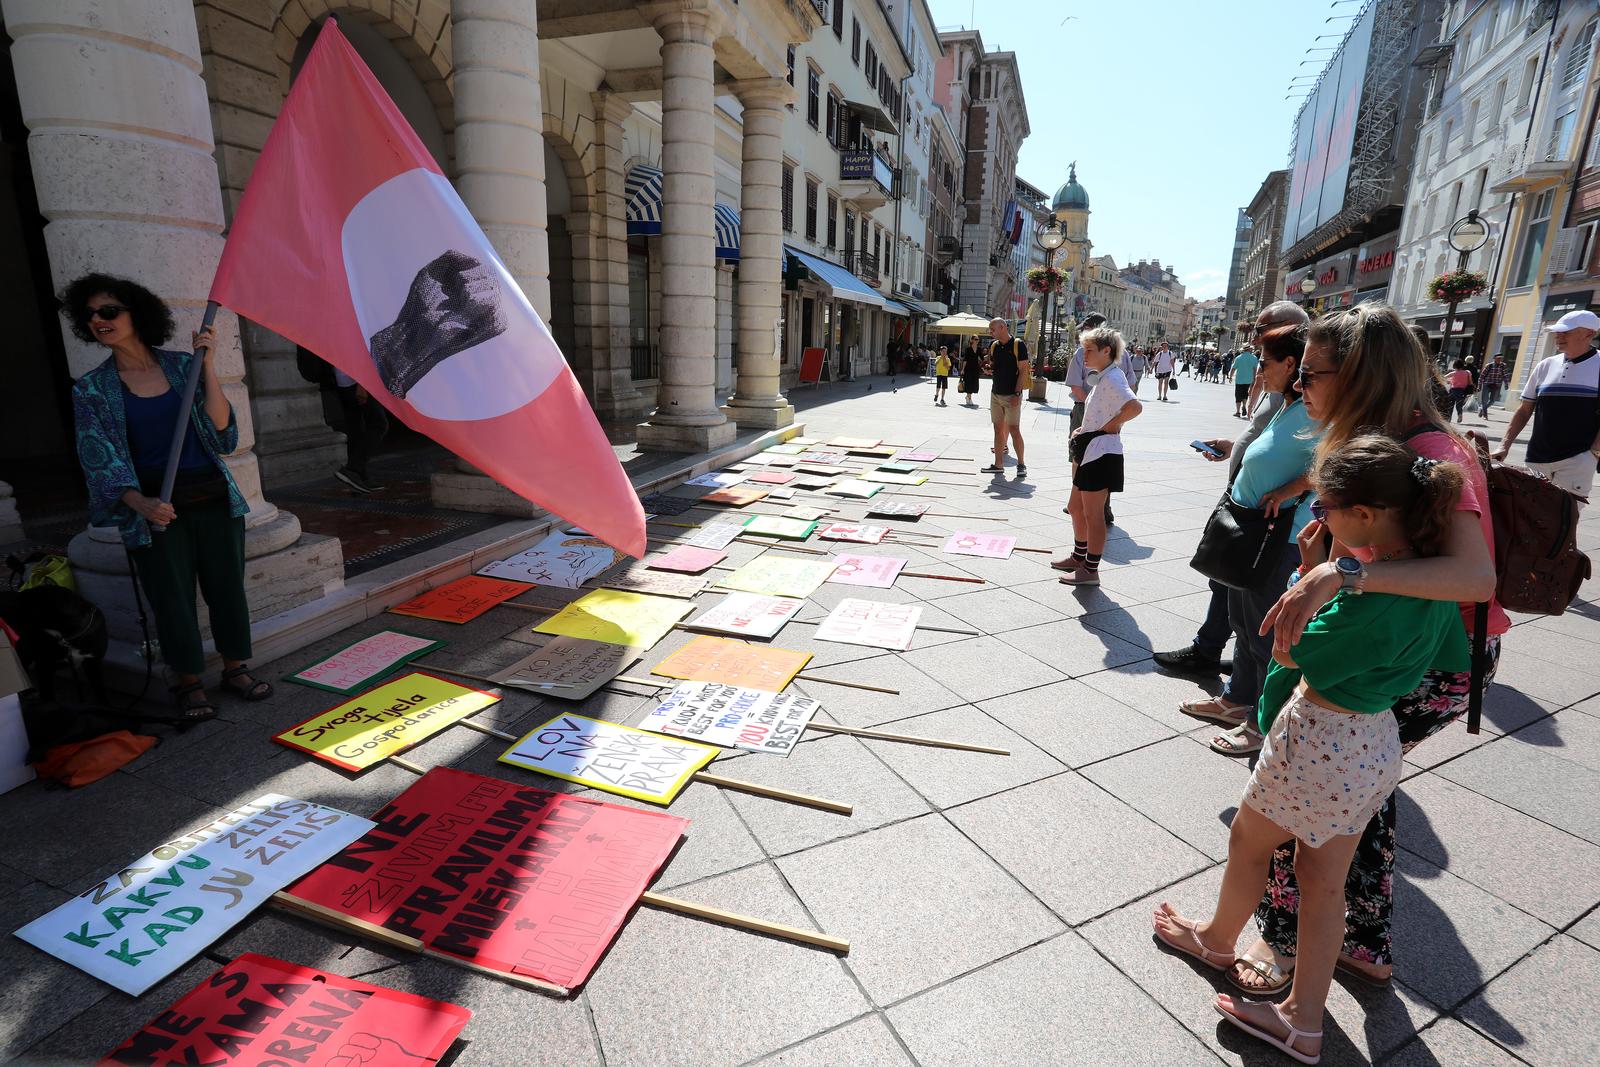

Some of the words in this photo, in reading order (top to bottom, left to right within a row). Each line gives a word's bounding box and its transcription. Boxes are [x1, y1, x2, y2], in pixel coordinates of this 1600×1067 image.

[1360, 250, 1394, 273] RIJEKA
[507, 659, 551, 678] TKO
[551, 646, 575, 656] JE
[293, 706, 367, 742] Svoga
[362, 694, 427, 724] tijela
[671, 704, 701, 726] KNOW
[687, 714, 714, 735] BEST
[706, 698, 728, 712] FOR
[719, 685, 738, 698] YOU
[714, 691, 760, 729] PRO-CHOICE
[786, 708, 804, 720] FOR
[791, 696, 814, 709] YOU
[334, 697, 459, 759] Gospodarica
[512, 717, 581, 761] LOV
[557, 733, 608, 759] NA
[661, 725, 685, 734] I
[735, 724, 769, 746] YOU
[755, 704, 780, 725] KNOW
[764, 720, 801, 749] BEST
[572, 733, 656, 785] ŽENSKA
[620, 745, 700, 794] PRAVA
[151, 804, 272, 860] OBITELJ
[326, 806, 430, 873] NE
[342, 812, 474, 914] ŽIVIM
[383, 790, 557, 939] PRAVILIMA
[430, 800, 604, 958] MUŠKARACA
[63, 853, 211, 948] KAKVU
[80, 867, 154, 905] ZA
[105, 906, 204, 967] KAD
[199, 867, 254, 910] JU
[210, 971, 250, 999] S
